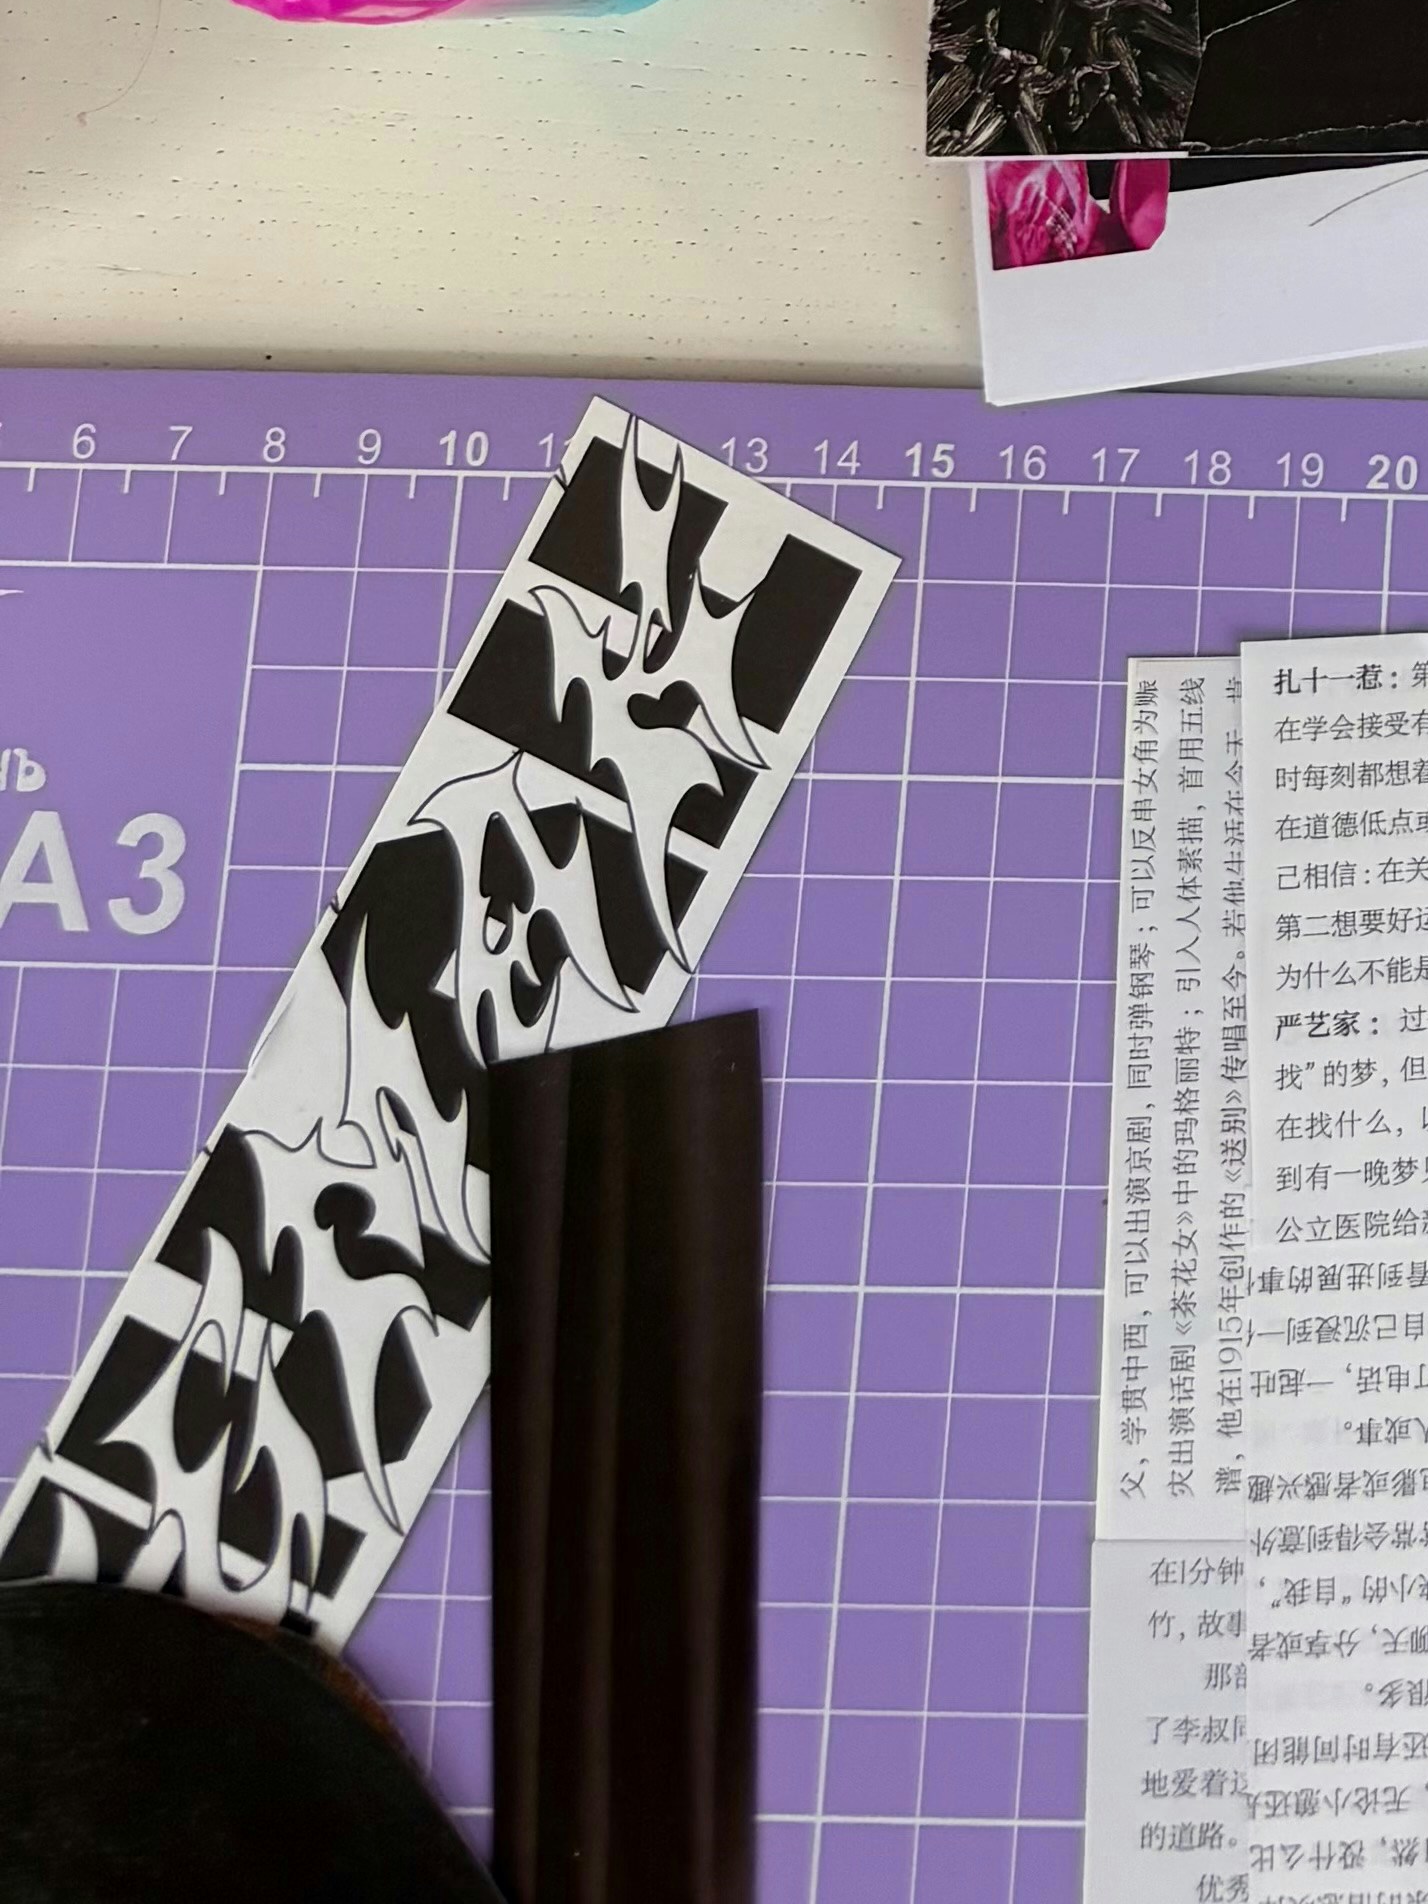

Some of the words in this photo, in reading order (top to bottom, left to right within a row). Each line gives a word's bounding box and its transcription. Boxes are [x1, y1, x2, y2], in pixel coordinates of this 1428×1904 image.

[68, 422, 97, 460] 6
[168, 425, 194, 462] 7
[259, 426, 287, 464] 8
[356, 428, 382, 465] 9
[438, 429, 490, 467] 10
[720, 436, 769, 474] 13
[814, 438, 861, 476] 14
[904, 441, 955, 479] 15
[999, 444, 1047, 481] 16
[1092, 447, 1141, 484] 17
[1183, 449, 1232, 487] 18
[1277, 451, 1325, 489] 19
[1365, 453, 1418, 491] 20
